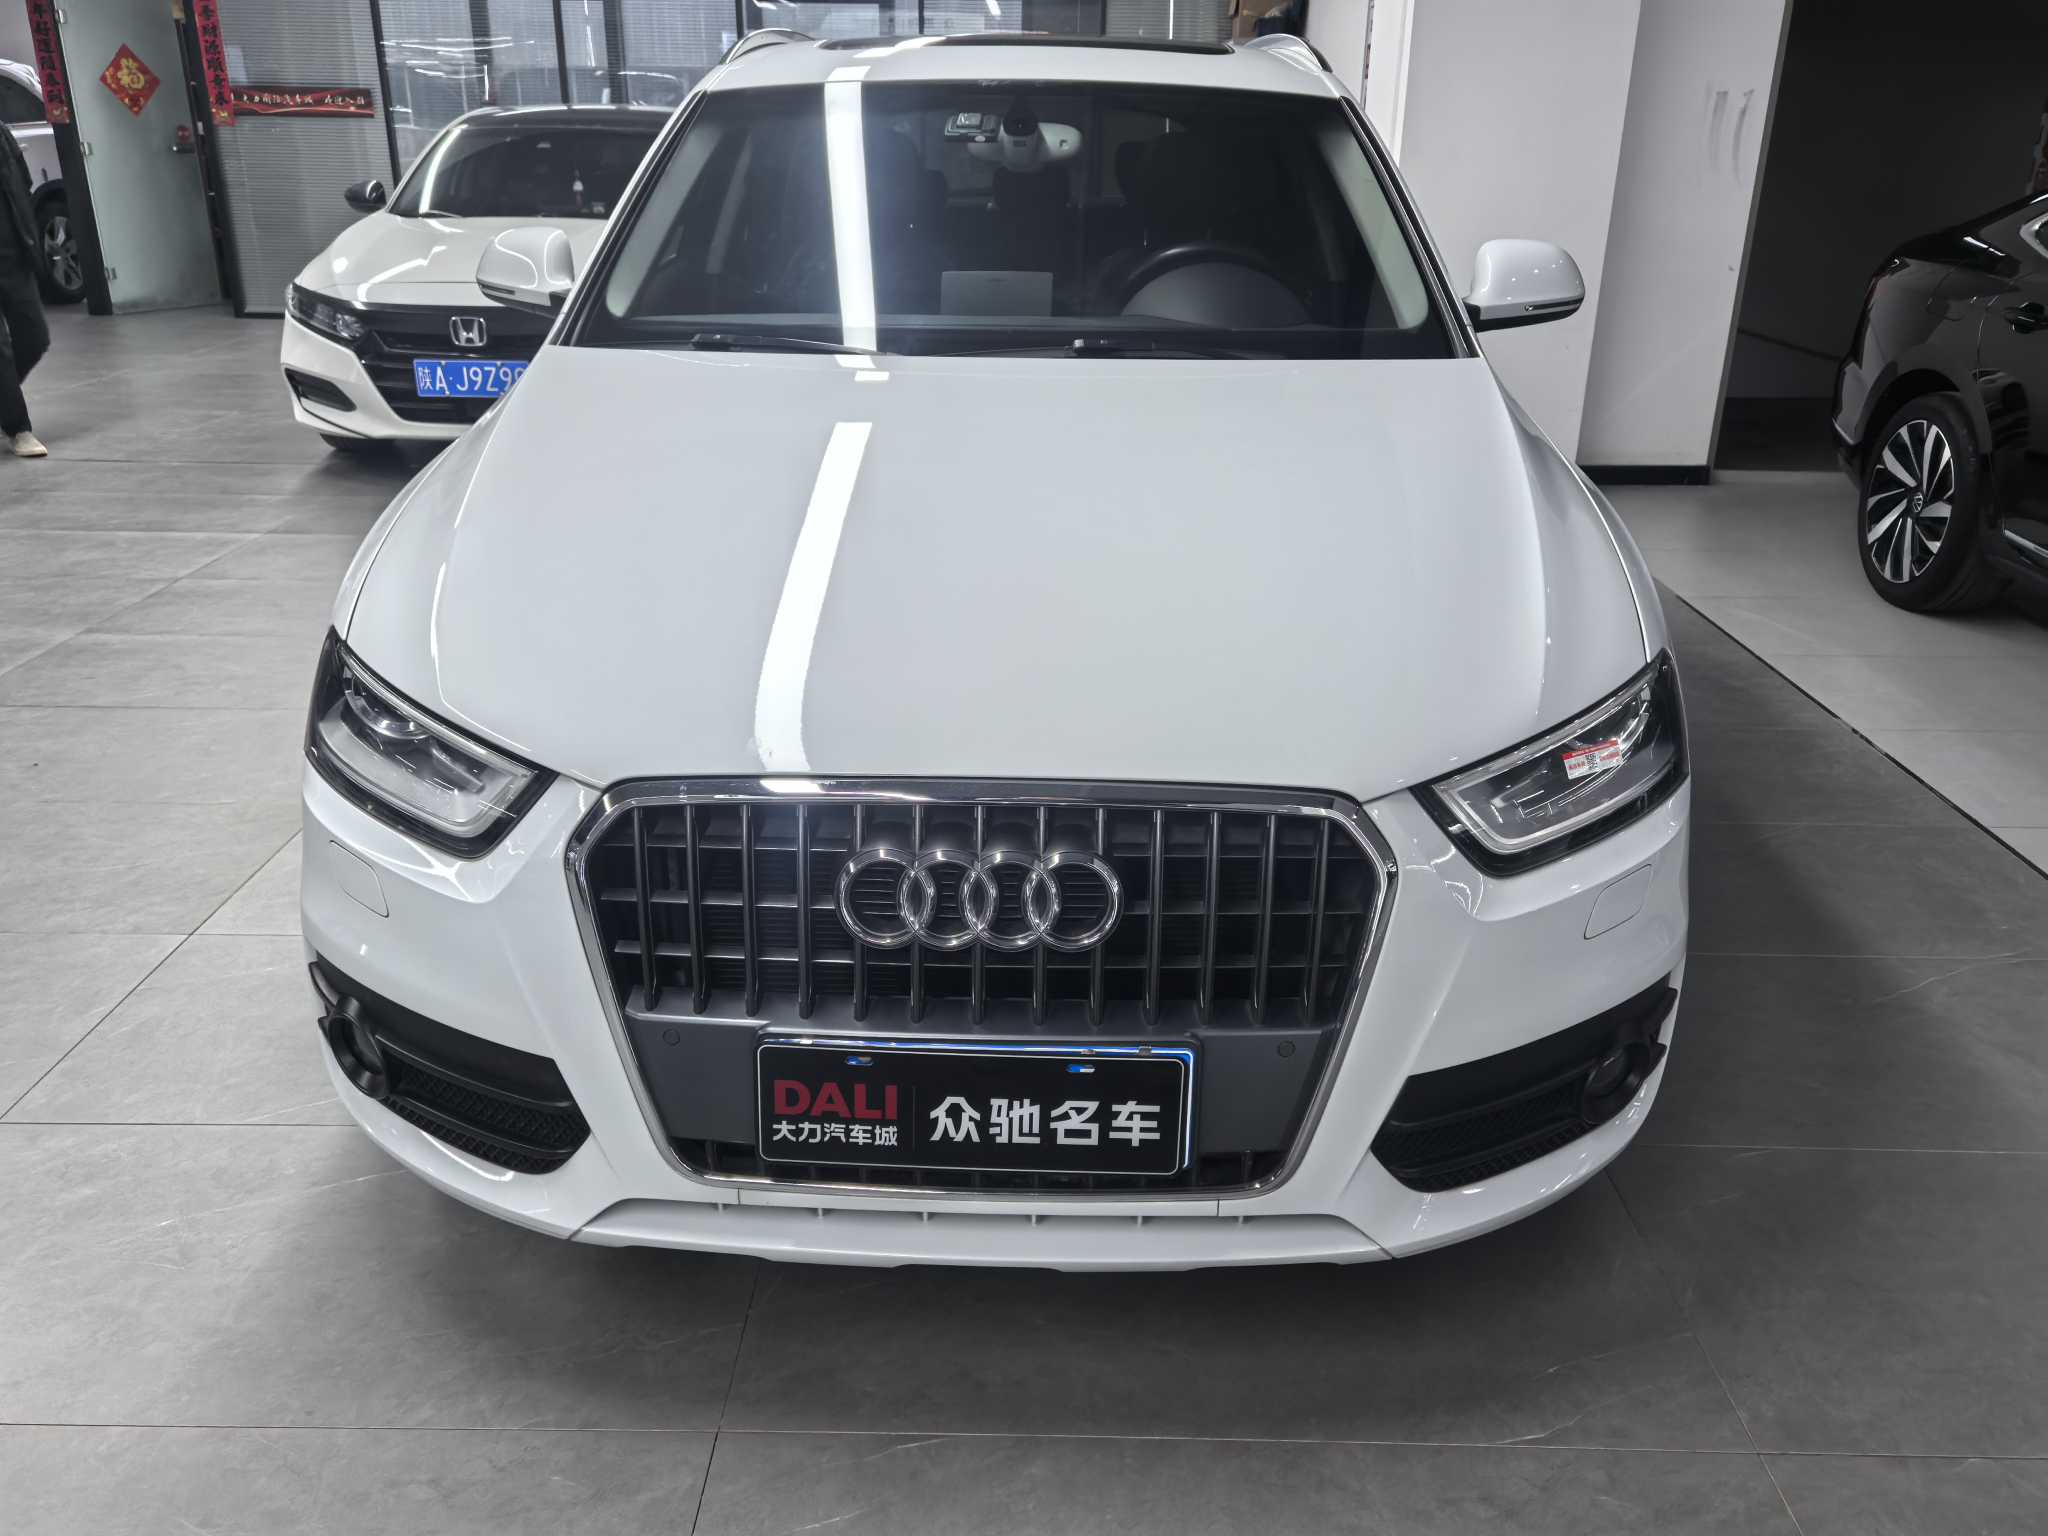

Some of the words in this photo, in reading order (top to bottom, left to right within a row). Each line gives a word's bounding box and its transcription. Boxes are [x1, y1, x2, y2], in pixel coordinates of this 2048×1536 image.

[117, 57, 145, 89] 福
[773, 1079, 898, 1120] DALI
[772, 1120, 898, 1147] 大力汽车城
[929, 1096, 1161, 1147] 众驰名车
